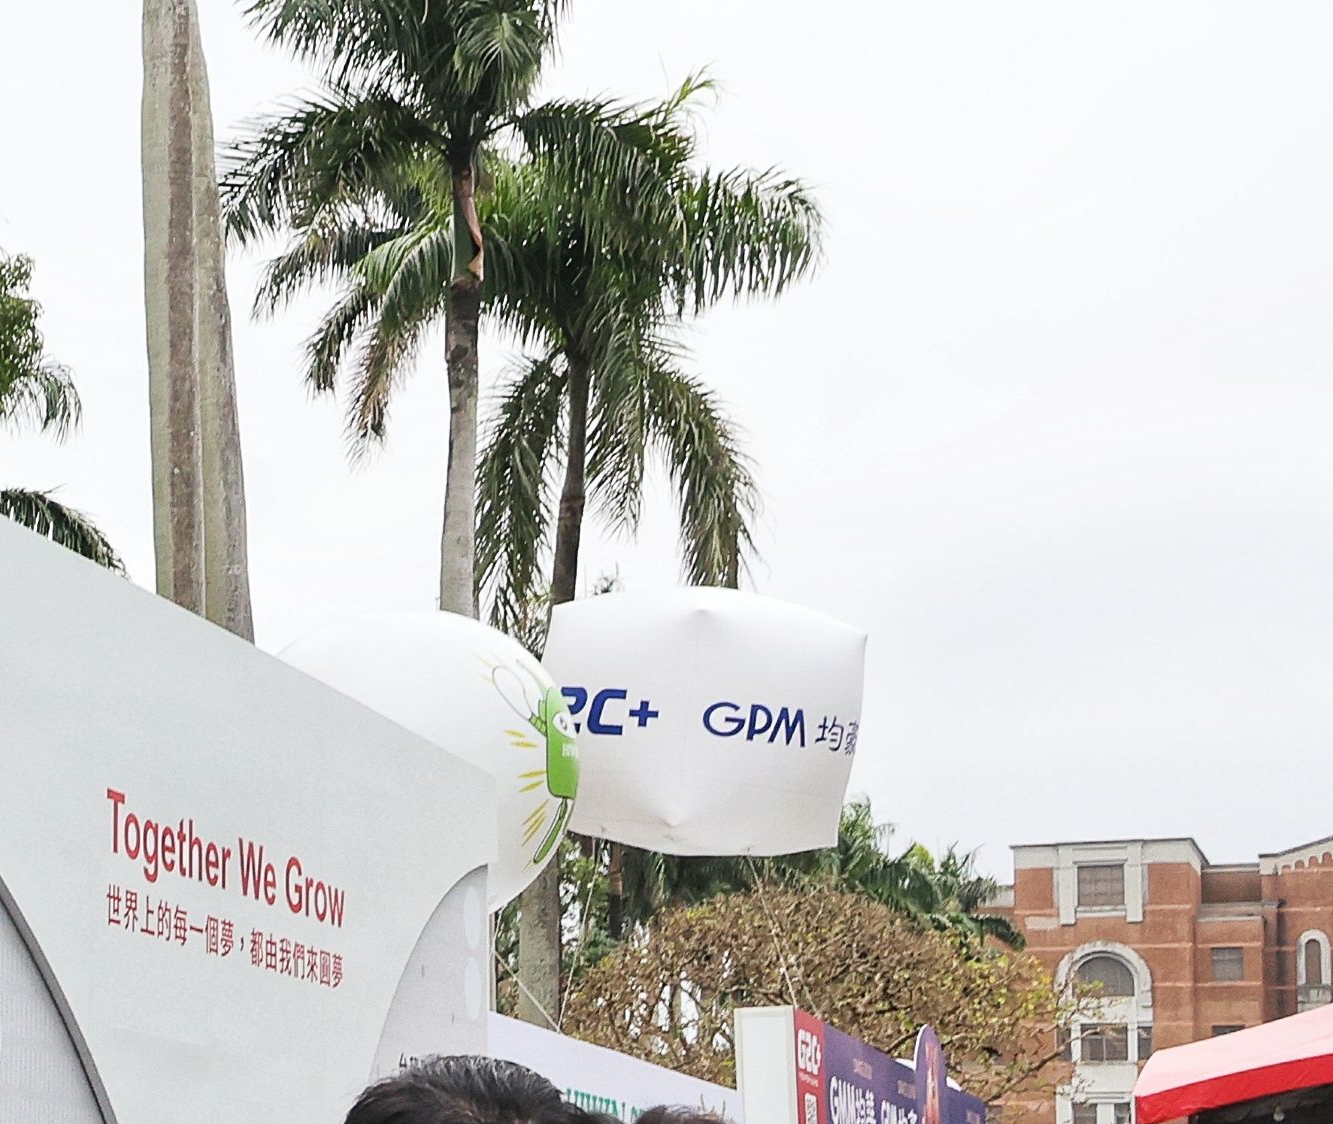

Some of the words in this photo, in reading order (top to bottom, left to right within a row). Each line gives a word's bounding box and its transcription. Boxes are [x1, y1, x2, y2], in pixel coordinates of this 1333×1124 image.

[703, 702, 806, 748] GPM
[106, 787, 231, 889] Together
[238, 837, 277, 906] We
[285, 856, 345, 928] Grow
